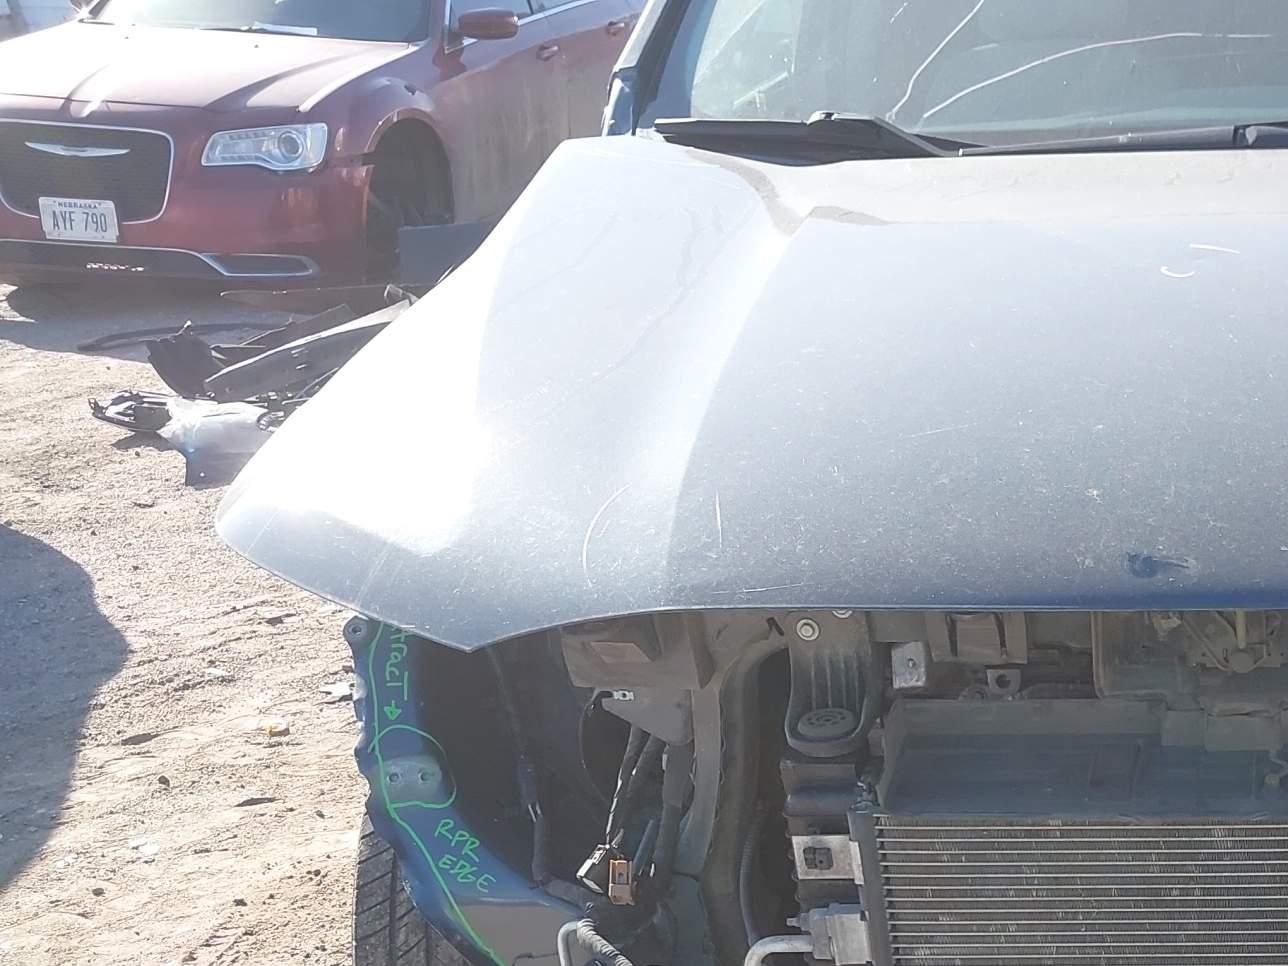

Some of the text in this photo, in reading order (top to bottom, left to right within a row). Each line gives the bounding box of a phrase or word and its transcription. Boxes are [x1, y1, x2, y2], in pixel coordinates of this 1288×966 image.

[52, 210, 108, 233] AYF 790
[438, 854, 497, 893] EDGE
